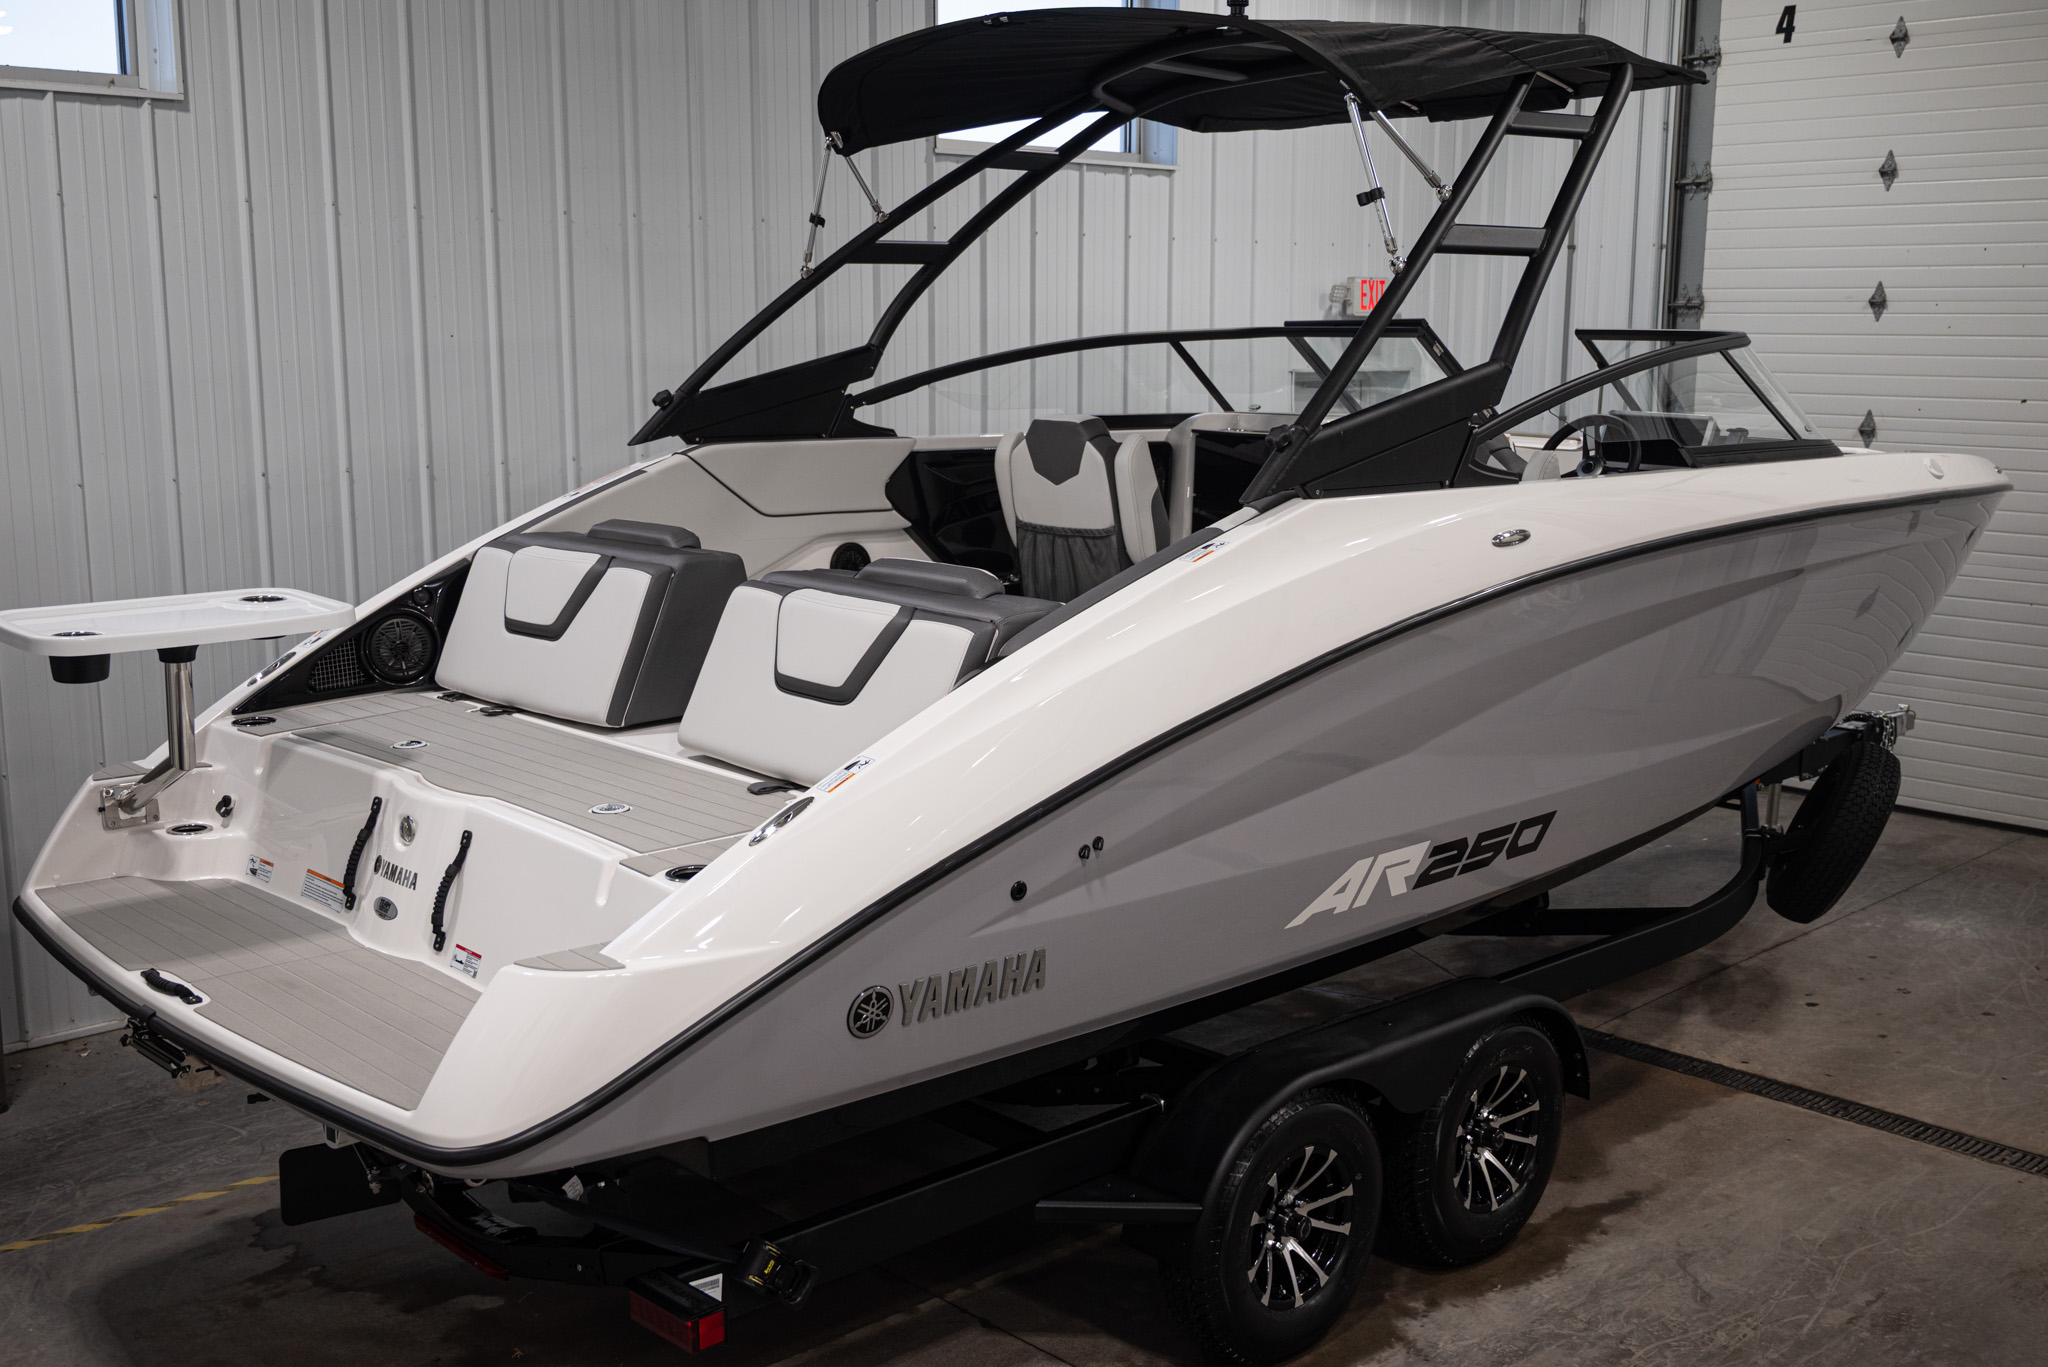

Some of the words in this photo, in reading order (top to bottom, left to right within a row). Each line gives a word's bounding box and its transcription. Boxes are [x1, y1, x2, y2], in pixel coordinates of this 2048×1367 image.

[1775, 4, 1796, 44] 4
[380, 860, 418, 891] YAMAHA
[898, 946, 1048, 1028] YAMAHA
